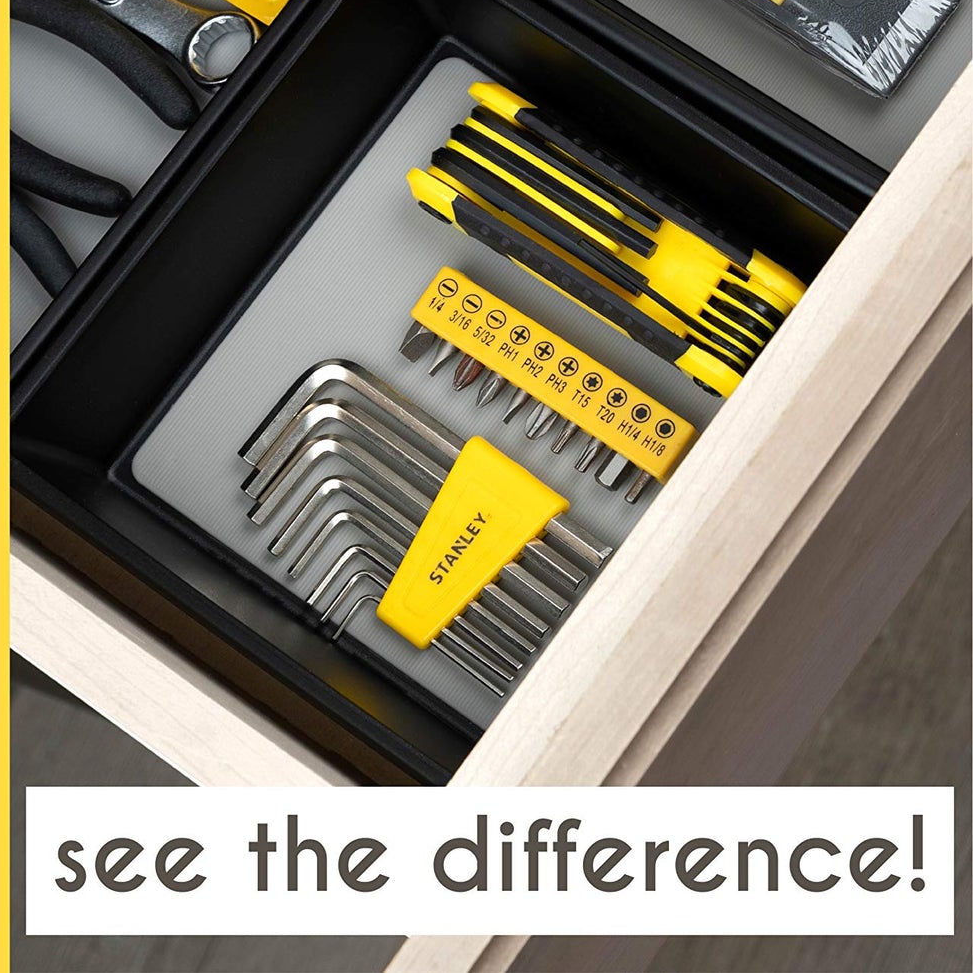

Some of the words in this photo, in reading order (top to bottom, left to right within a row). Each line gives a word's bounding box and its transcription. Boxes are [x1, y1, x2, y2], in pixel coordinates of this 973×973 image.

[428, 296, 445, 313] 1/4
[448, 310, 472, 331] 3/16
[472, 325, 495, 346] 5/32
[498, 342, 518, 362] PH1
[521, 358, 543, 378] PH2
[545, 373, 567, 393] PH3
[572, 389, 591, 408] T15
[596, 404, 615, 424] T20
[617, 422, 639, 442] H1/4
[641, 437, 666, 457] H1/8
[429, 512, 486, 585] STANLEY
